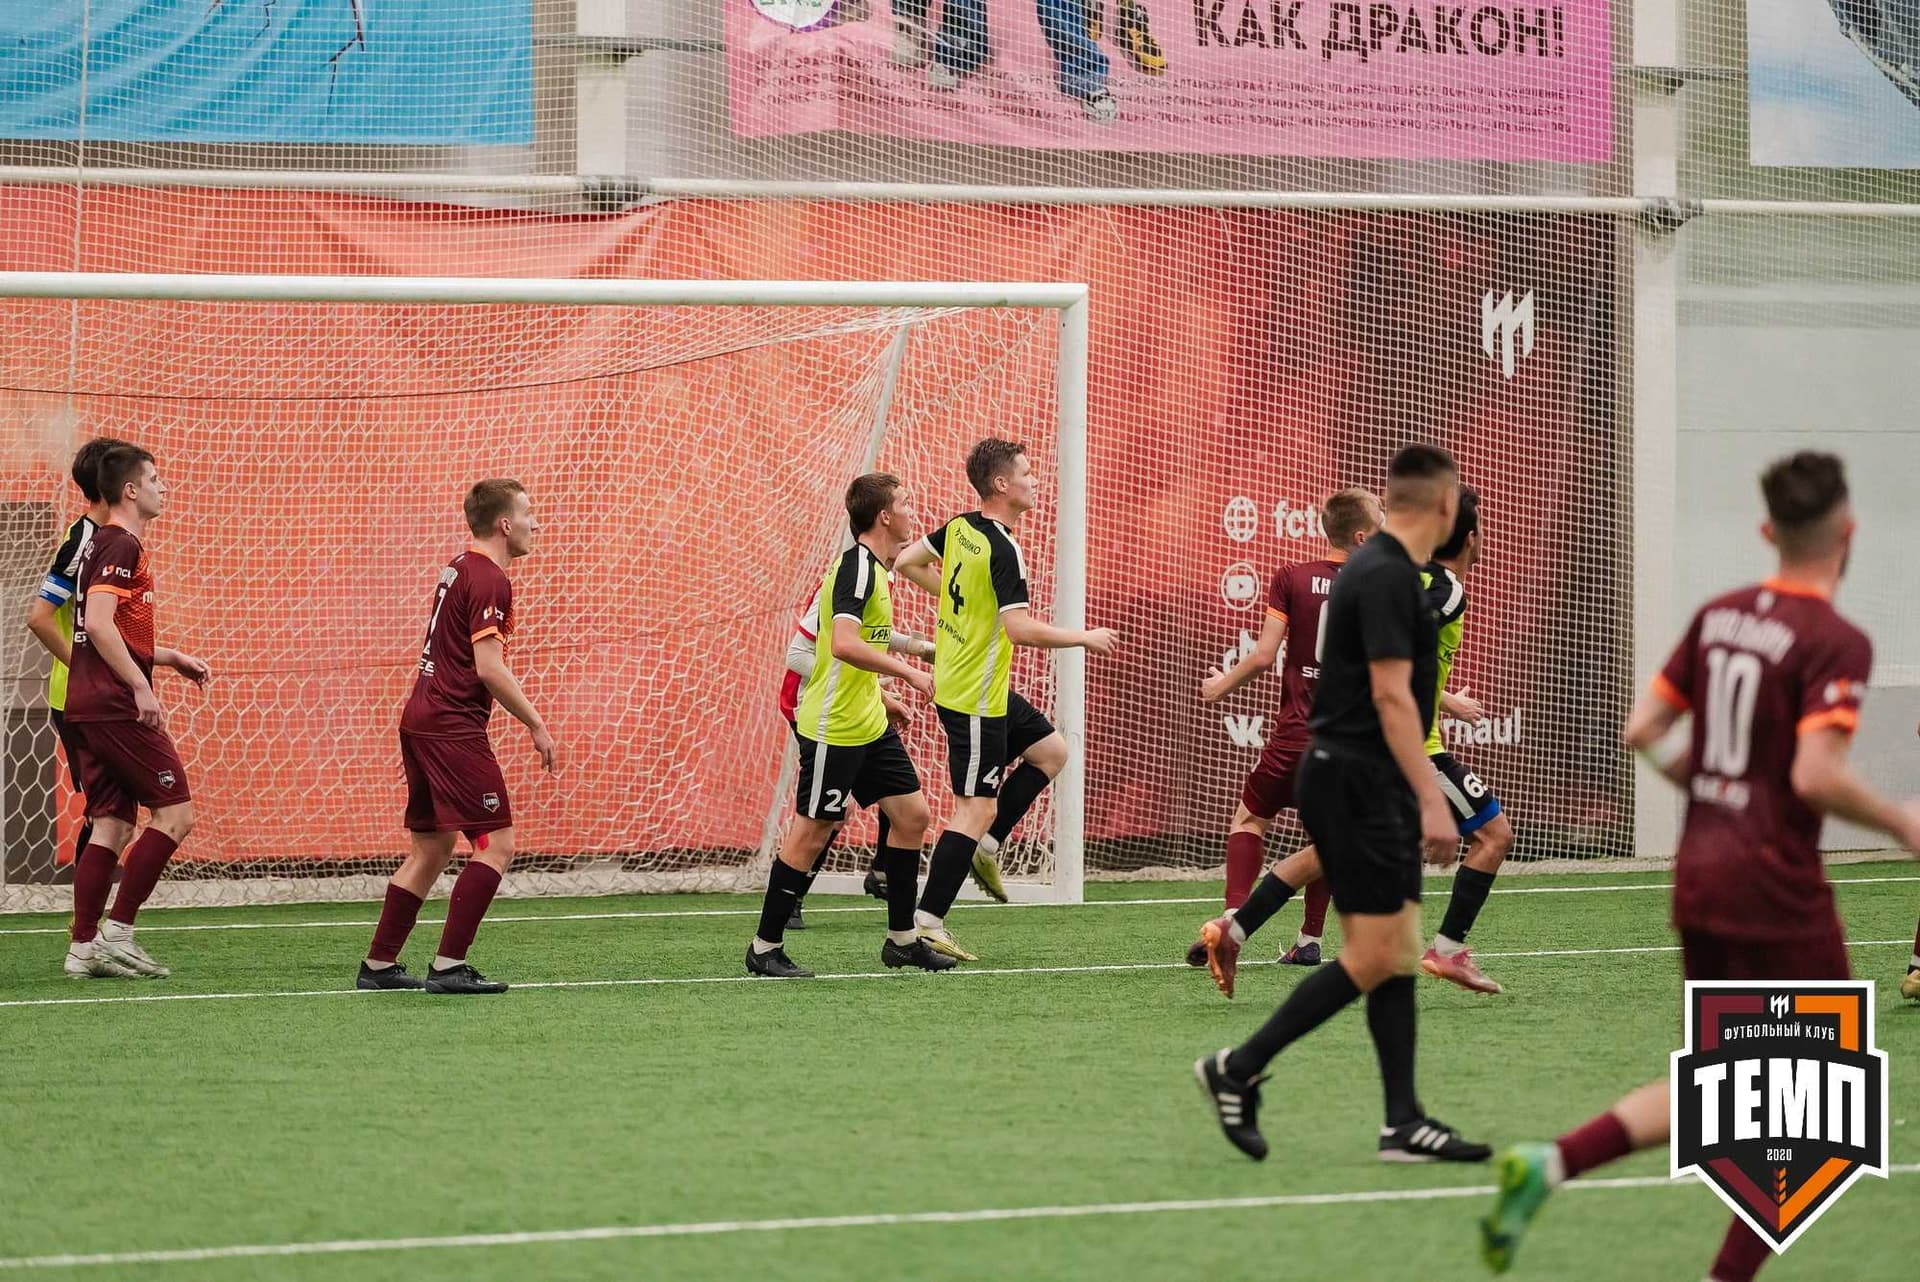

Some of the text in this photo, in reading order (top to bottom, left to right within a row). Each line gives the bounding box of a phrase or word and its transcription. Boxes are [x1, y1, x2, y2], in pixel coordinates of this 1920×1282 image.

[1194, 0, 1563, 62] КАК ДРАКОН!
[948, 561, 964, 615] 4
[1443, 707, 1521, 745] rnaul
[1703, 647, 1762, 778] 10
[982, 766, 1000, 790] 4
[1463, 771, 1488, 798] 6
